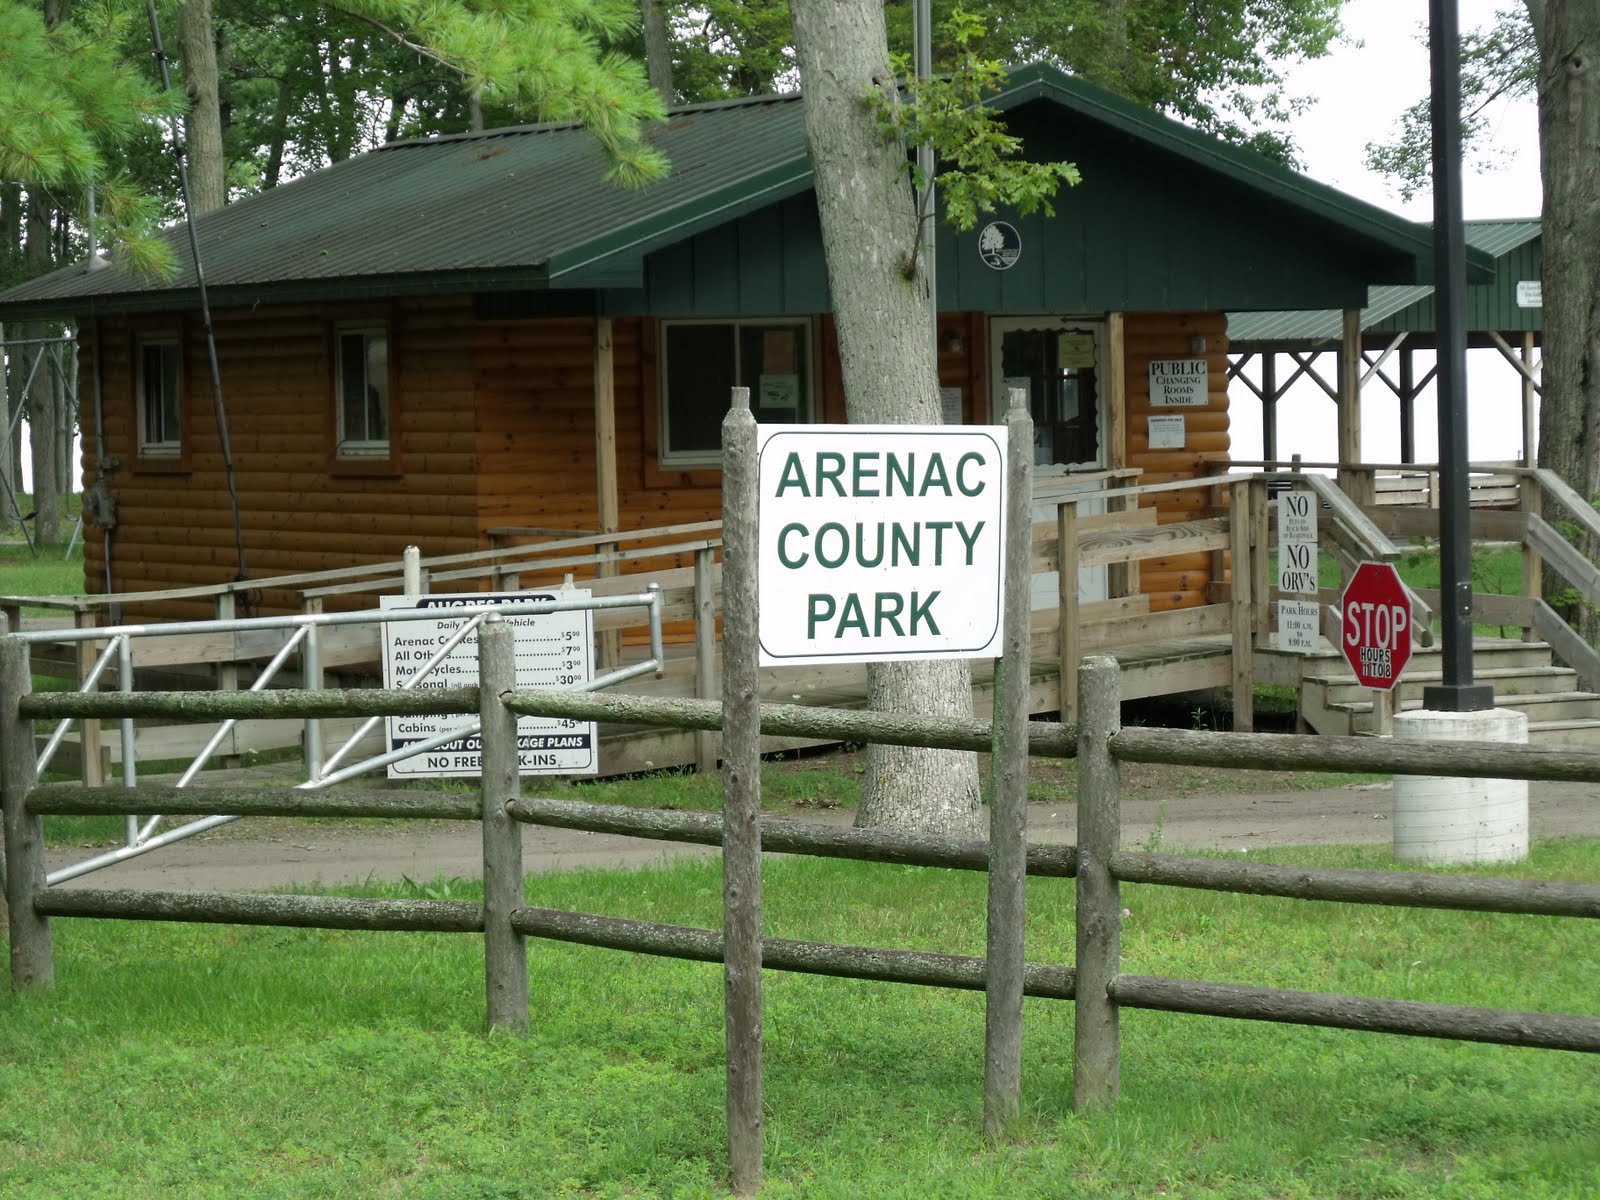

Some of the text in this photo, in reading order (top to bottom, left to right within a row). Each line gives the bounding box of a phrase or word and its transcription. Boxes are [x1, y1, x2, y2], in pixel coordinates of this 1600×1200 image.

[1151, 361, 1206, 376] PUBLIC
[775, 452, 986, 498] ARENAC
[1286, 495, 1309, 517] NO
[777, 521, 986, 569] COUNTY
[1286, 544, 1310, 570] NO
[807, 591, 942, 640] PARK
[437, 621, 460, 630] Daily
[1346, 601, 1407, 650] STOP
[394, 636, 434, 647] Arenac
[394, 650, 410, 661] All
[1361, 648, 1390, 662] HOURS
[398, 722, 436, 733] Cabins
[547, 736, 583, 748] PLANS
[427, 757, 449, 768] NO
